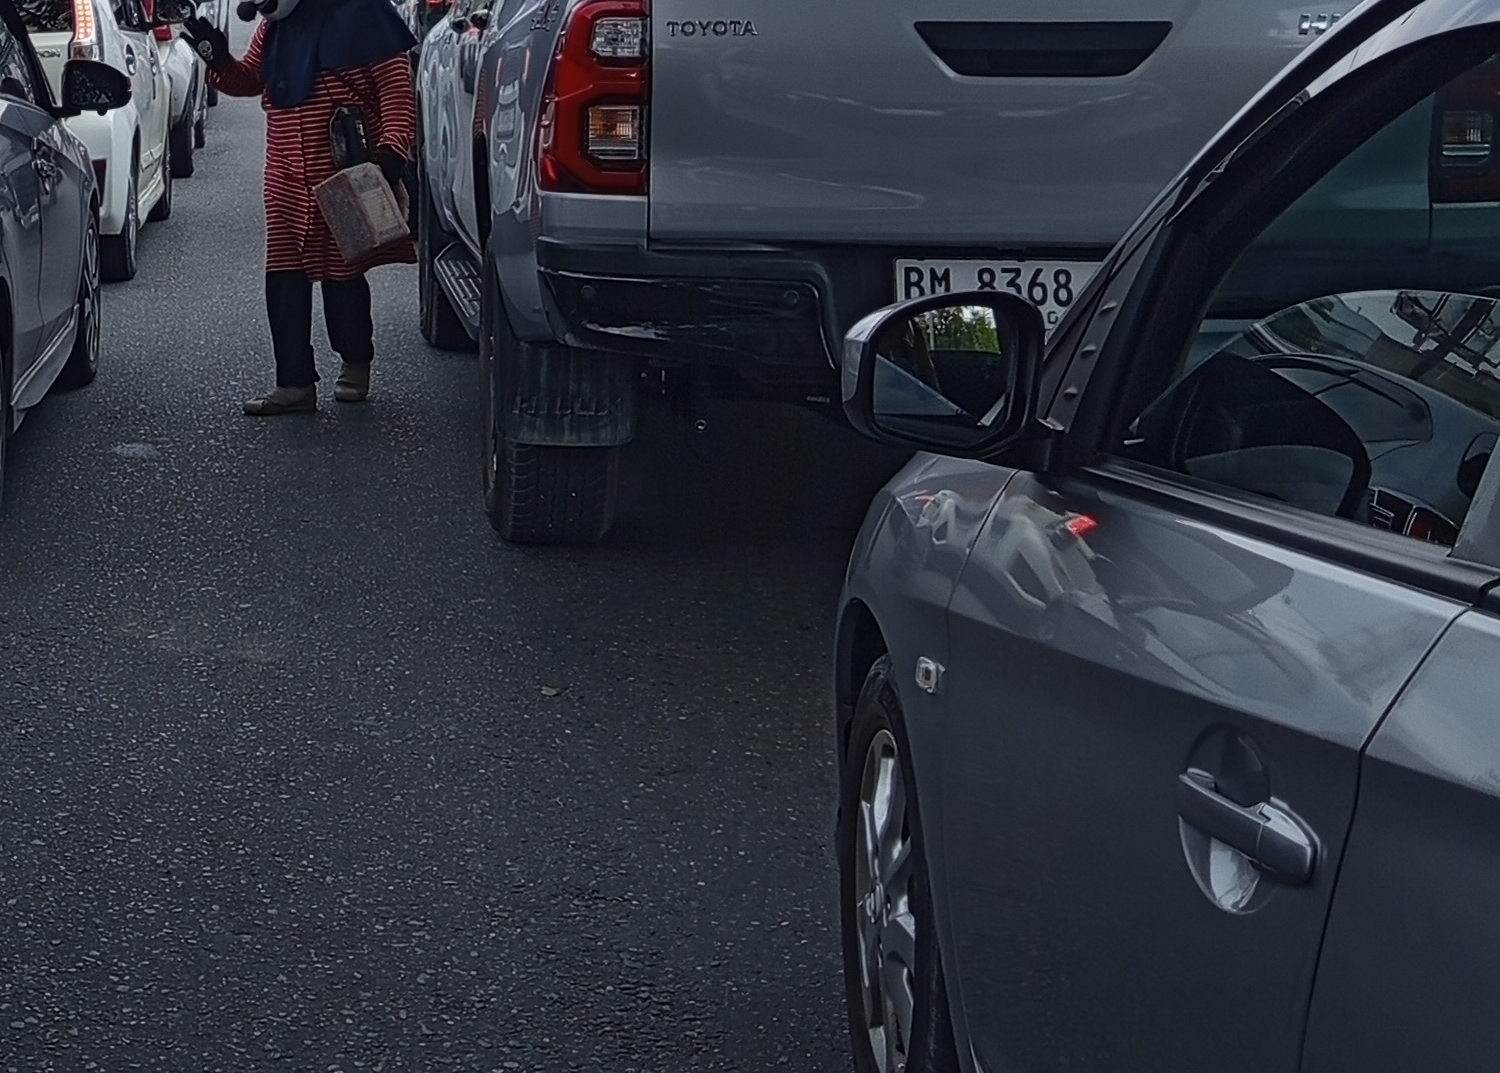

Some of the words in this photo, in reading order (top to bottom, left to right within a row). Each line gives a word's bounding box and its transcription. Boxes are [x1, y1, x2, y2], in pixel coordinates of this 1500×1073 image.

[666, 21, 758, 37] TOYOTA
[903, 266, 950, 300] BM
[976, 267, 1074, 307] 8368
